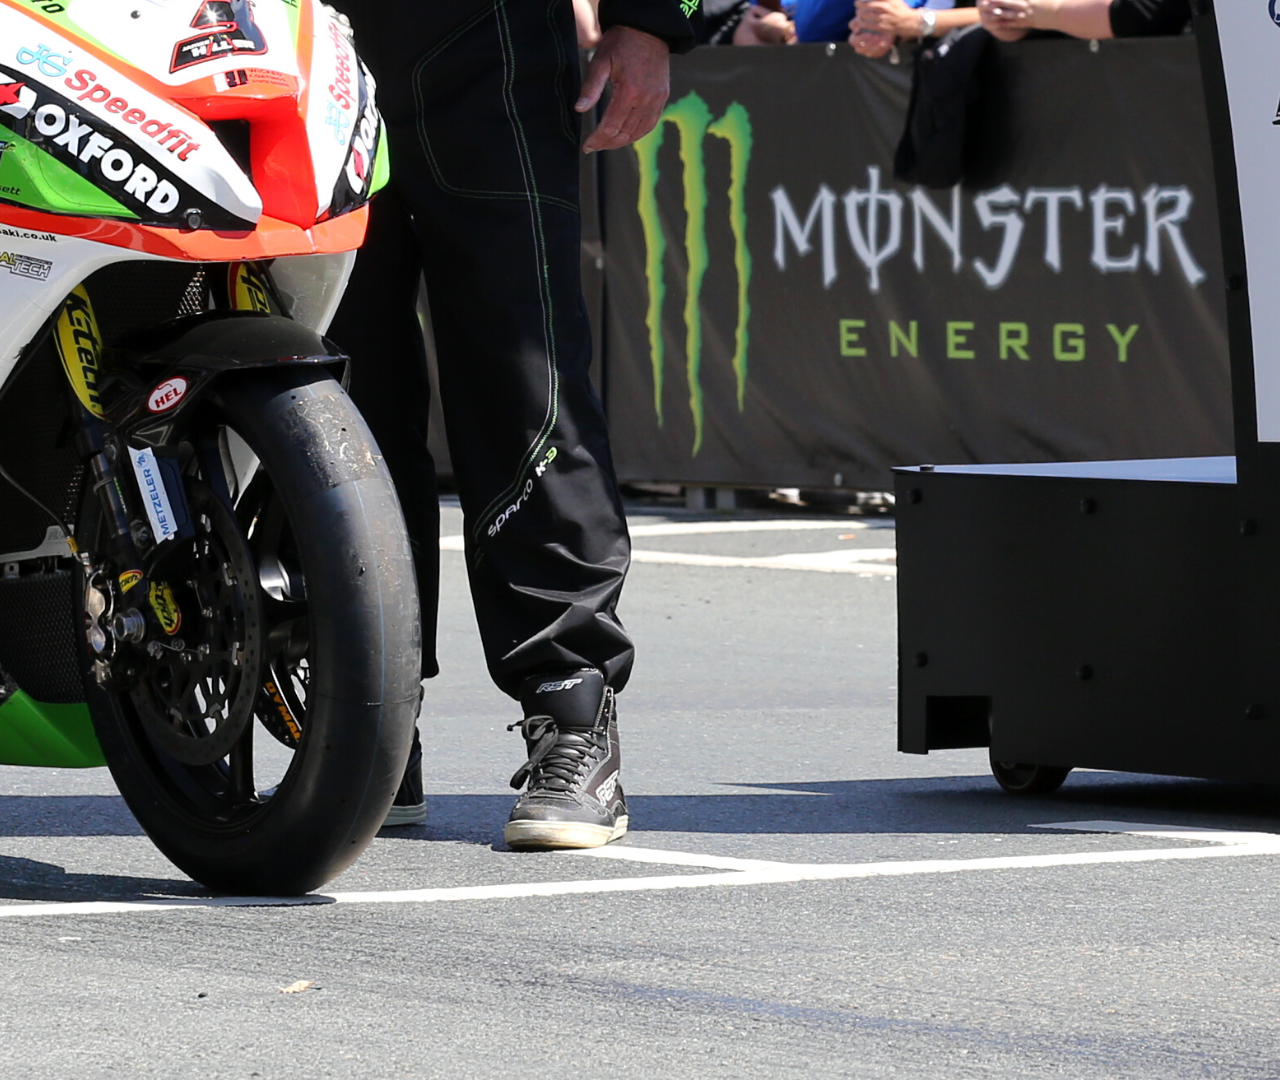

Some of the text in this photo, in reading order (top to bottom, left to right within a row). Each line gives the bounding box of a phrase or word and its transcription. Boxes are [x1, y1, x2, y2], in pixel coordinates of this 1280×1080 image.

[63, 70, 201, 162] Speedfit
[34, 103, 180, 214] OXFORD
[770, 165, 1206, 294] MONSTER
[13, 260, 51, 278] TECH
[839, 319, 1139, 362] ENERGY
[154, 386, 183, 409] HEL
[147, 467, 172, 536] METZELER
[487, 477, 533, 538] sparco
[536, 677, 584, 694] RST
